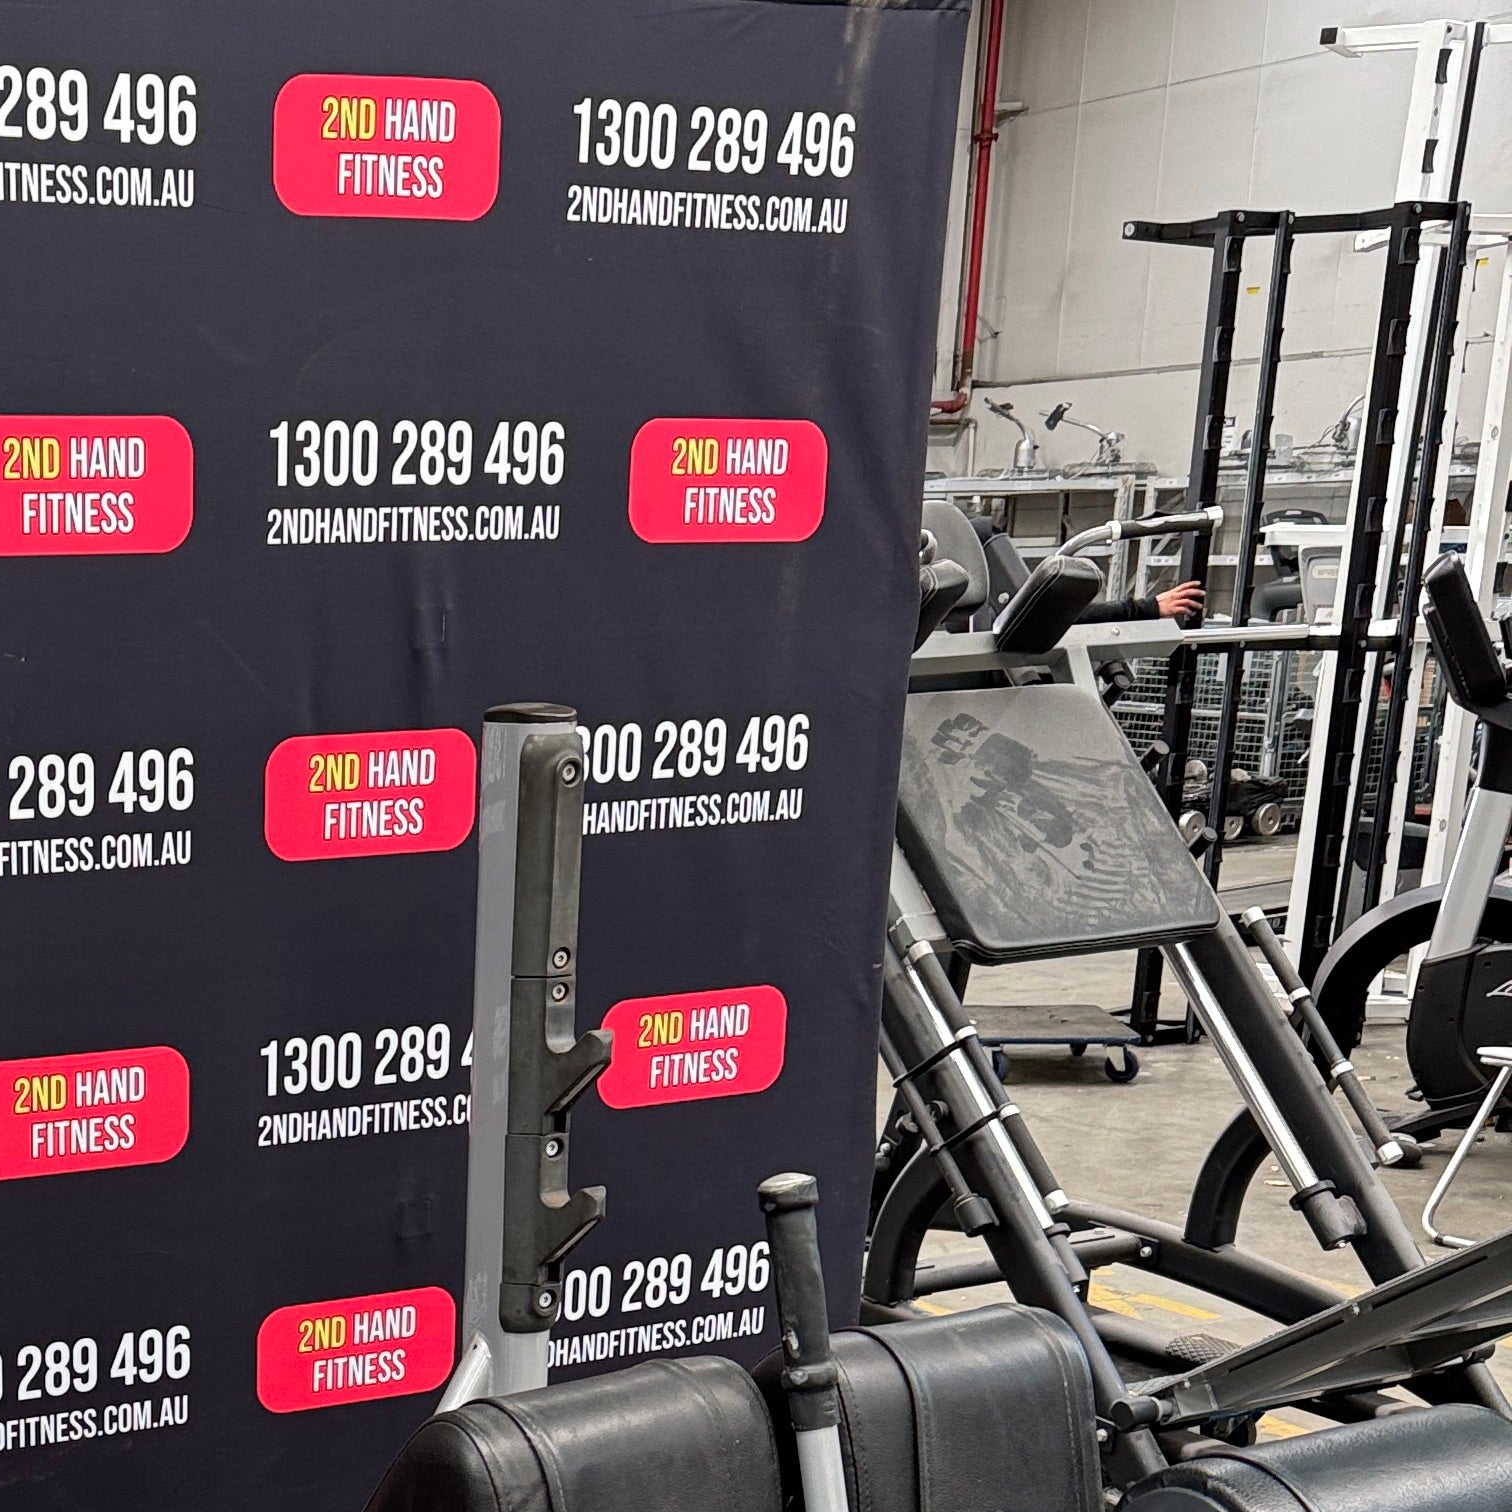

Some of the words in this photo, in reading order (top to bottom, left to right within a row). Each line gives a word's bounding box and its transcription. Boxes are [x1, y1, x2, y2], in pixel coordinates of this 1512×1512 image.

[103, 72, 197, 147] 496
[322, 96, 376, 140] 2ND
[384, 98, 456, 143] HAND
[573, 97, 678, 170] 1300
[687, 106, 769, 175] 289
[776, 111, 856, 178] 496
[338, 153, 444, 199] FITNESS
[566, 184, 849, 234] 2NDHANDFITNESS.COM.AU
[3, 437, 60, 479] 2ND
[70, 437, 145, 478] HAND
[269, 419, 379, 488] 1300
[391, 419, 473, 486] 289
[483, 420, 566, 486] 496
[671, 437, 719, 475] 2ND
[725, 438, 789, 475] HAND
[22, 491, 134, 534] FITNESS
[266, 505, 561, 545] 2NDHANDFITNESS.COM.AU
[684, 487, 777, 524] FITNESS
[309, 753, 360, 792] 2ND
[368, 748, 436, 788] HAND
[575, 722, 642, 784] 300
[651, 717, 727, 780] 289
[735, 713, 810, 774] 496
[8, 752, 95, 820] 289
[108, 747, 194, 814] 496
[324, 797, 424, 840] FITNESS
[582, 787, 804, 836] HANDFITNESS.COM.AU
[638, 1011, 684, 1048] 2ND
[690, 1003, 750, 1042] HAND
[260, 1031, 362, 1097] 1300
[374, 1023, 451, 1086] 289
[650, 1047, 739, 1089] FITNESS
[14, 1074, 67, 1114] 2ND
[75, 1066, 145, 1108] HAND
[32, 1113, 135, 1158] FITNESS
[257, 1093, 473, 1148] 2NDHANDFITNESS.C
[553, 1264, 612, 1323] 00
[620, 1253, 692, 1313] 289
[700, 1240, 771, 1299] 496
[298, 1316, 346, 1353] 2ND
[353, 1305, 416, 1345] HAND
[17, 1337, 98, 1401] 289
[110, 1324, 191, 1386] 496
[313, 1348, 406, 1392] FITNESS
